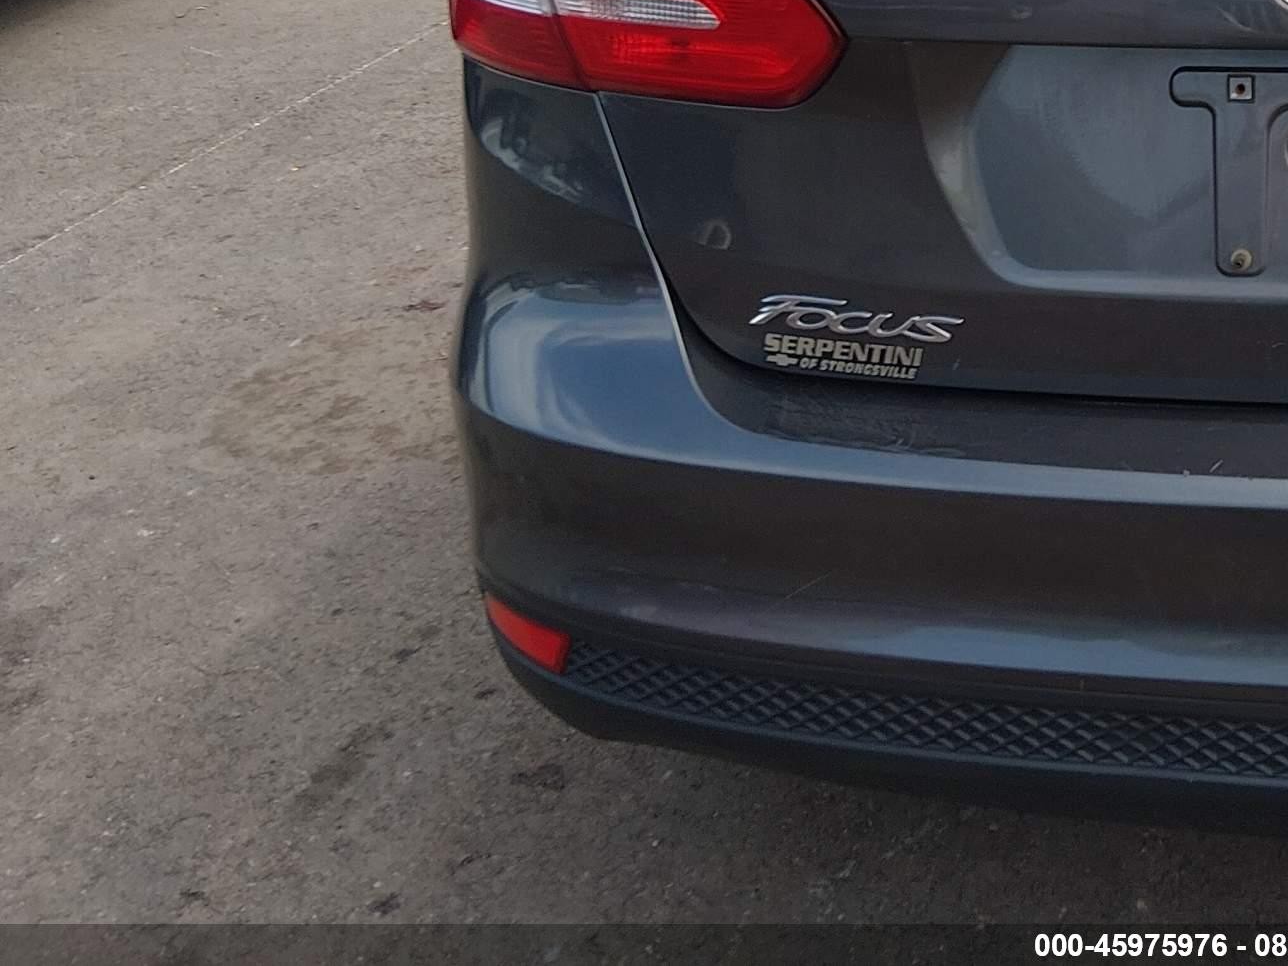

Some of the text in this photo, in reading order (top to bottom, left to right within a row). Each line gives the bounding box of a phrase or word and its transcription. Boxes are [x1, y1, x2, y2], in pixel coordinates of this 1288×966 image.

[763, 333, 923, 367] SERPENTINI
[801, 357, 918, 379] OF STRONGSVILLE
